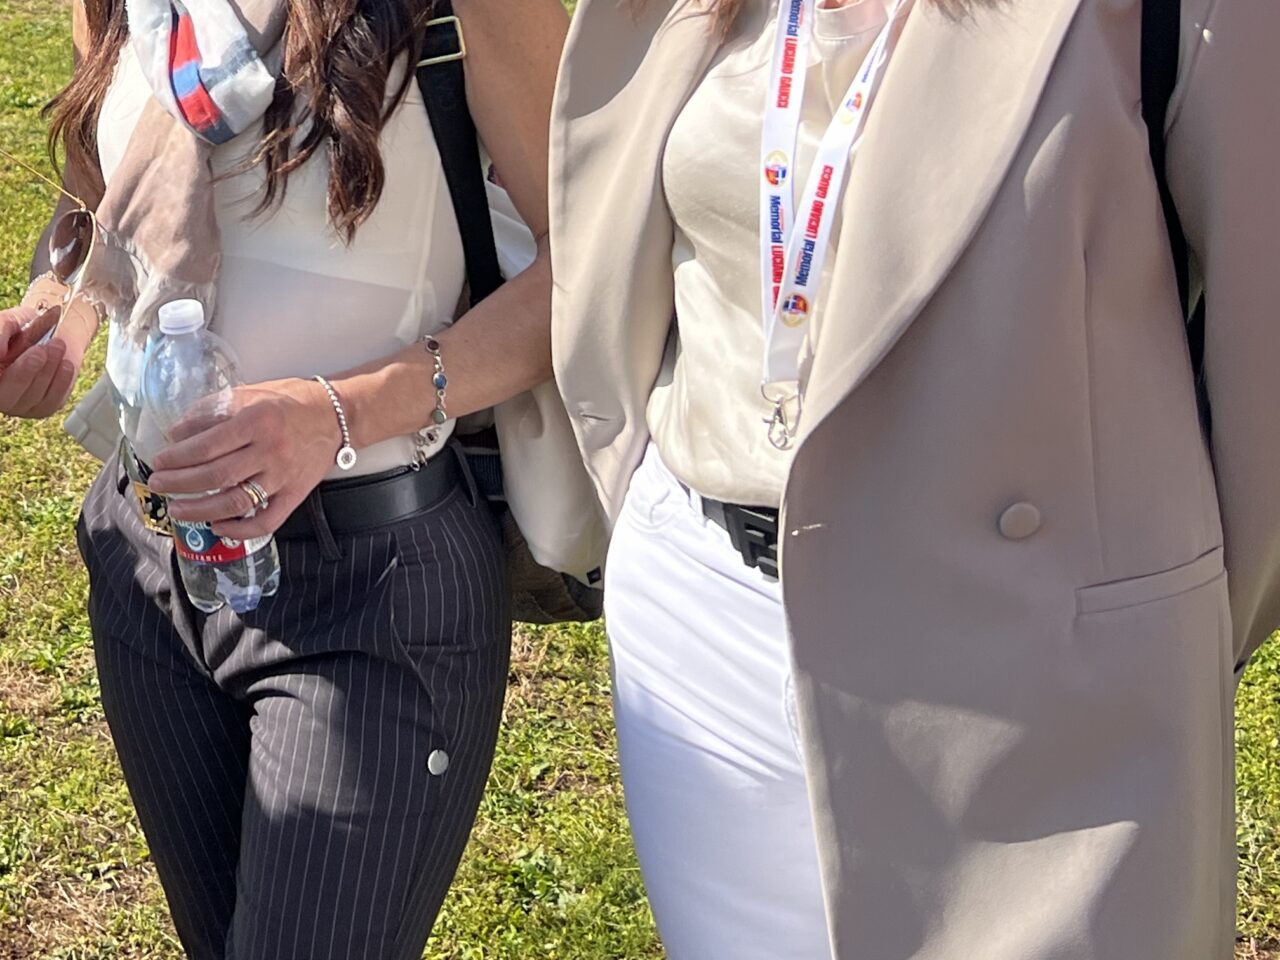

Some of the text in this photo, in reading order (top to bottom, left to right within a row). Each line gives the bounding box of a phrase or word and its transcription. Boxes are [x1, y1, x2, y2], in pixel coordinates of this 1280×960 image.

[781, 38, 798, 74] LUCIANO
[776, 76, 792, 108] GAUCCI
[770, 195, 784, 243] Memorial
[794, 165, 834, 287] Memorial LUCIANO GAUCCI
